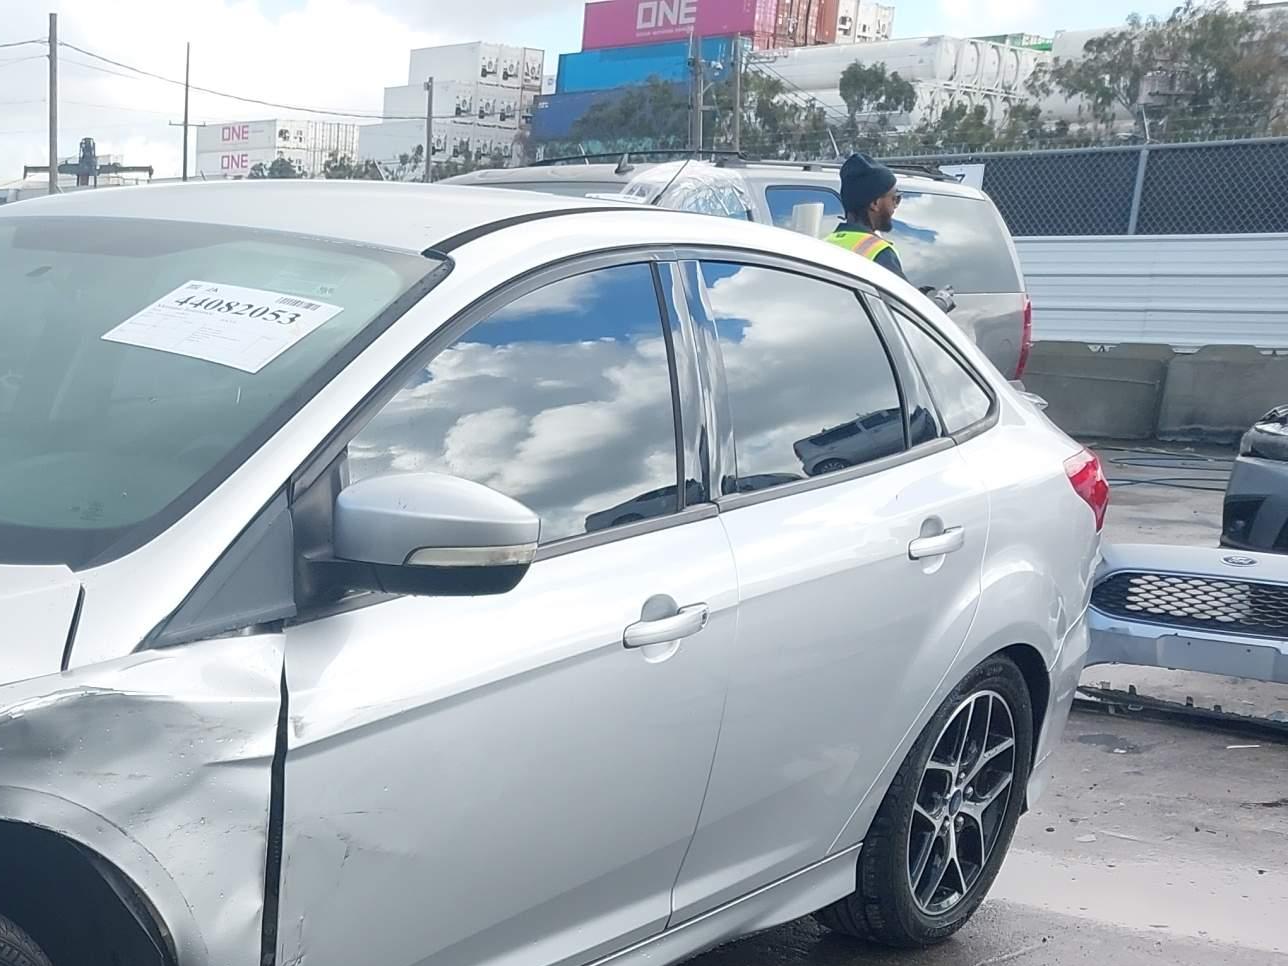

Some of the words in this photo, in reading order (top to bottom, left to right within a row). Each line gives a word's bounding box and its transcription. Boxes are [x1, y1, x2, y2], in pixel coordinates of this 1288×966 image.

[636, 0, 697, 29] ONE
[222, 125, 249, 142] ONE
[221, 154, 249, 170] ONE
[175, 295, 302, 325] 44082053
